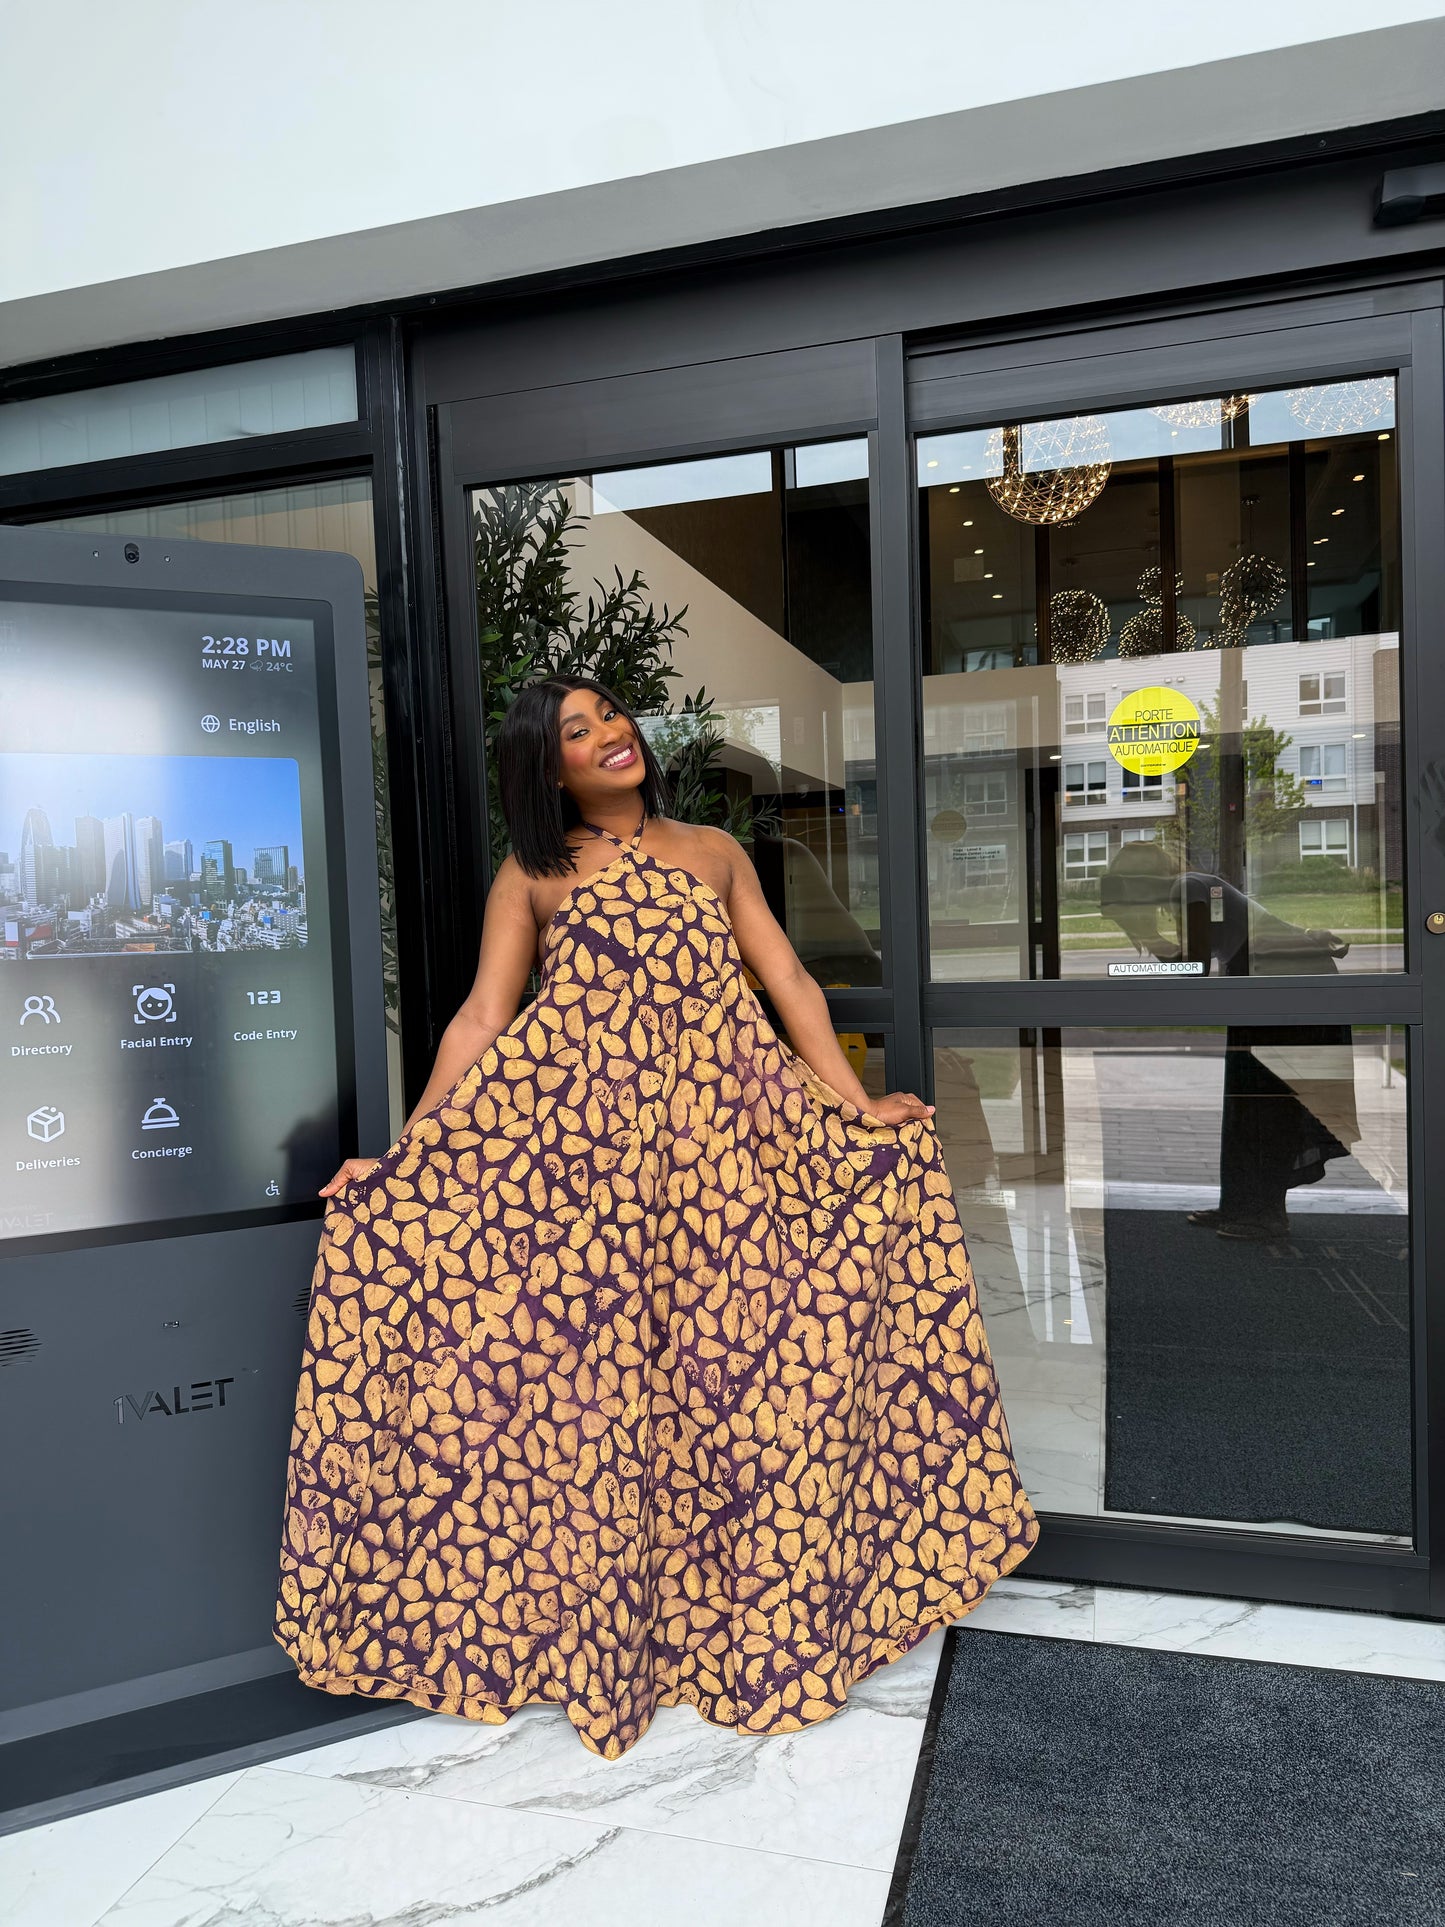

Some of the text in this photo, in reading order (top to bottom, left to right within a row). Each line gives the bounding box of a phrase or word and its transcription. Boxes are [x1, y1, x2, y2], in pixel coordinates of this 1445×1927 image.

[201, 635, 292, 658] 2:28 PM
[202, 658, 294, 673] MAY 27 24°C
[1135, 708, 1174, 722] PORTE
[229, 718, 281, 735] English
[1109, 721, 1198, 742] ATTENTION
[1114, 740, 1194, 757] AUTOMATIQUE
[1113, 963, 1199, 973] AUTOMATIC DOOR
[246, 990, 281, 1005] 123
[120, 1036, 193, 1049] Facial Entry
[233, 1029, 298, 1041] Code Entry
[11, 1044, 73, 1056] Directory
[131, 1146, 193, 1160] Concierge
[15, 1156, 81, 1171] Deliveries
[112, 1377, 235, 1425] 1VALET
